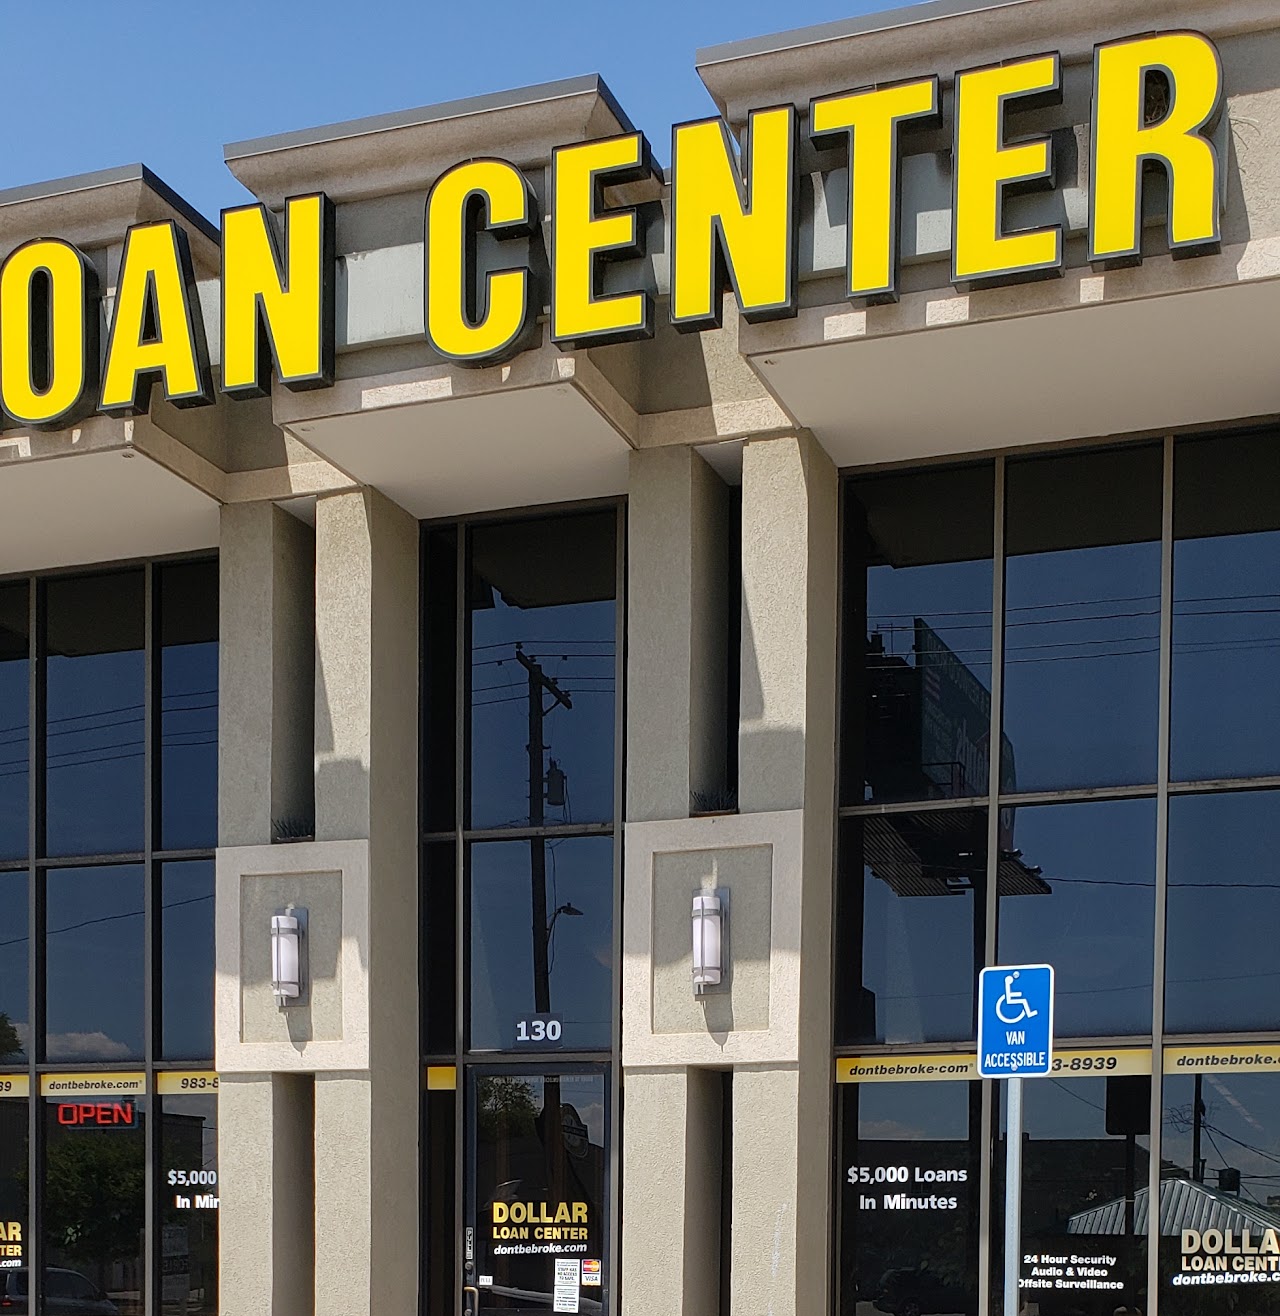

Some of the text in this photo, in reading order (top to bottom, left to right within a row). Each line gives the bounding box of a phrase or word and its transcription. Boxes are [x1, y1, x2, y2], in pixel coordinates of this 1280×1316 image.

[0, 29, 1223, 431] OAN CENTER
[516, 1020, 561, 1041] 130
[1006, 1031, 1025, 1045] VAN
[984, 1052, 1046, 1068] ACCESSIBLE
[1176, 1054, 1280, 1067] dontbebroke.
[57, 1103, 134, 1125] OPEN
[167, 1168, 217, 1186] $5,000
[847, 1165, 968, 1184] $5,000 Loans
[176, 1194, 191, 1209] In
[859, 1193, 958, 1210] In Minutes
[492, 1202, 588, 1224] DOLLAR
[492, 1227, 588, 1240] LOAN CENTER
[1181, 1228, 1280, 1255] DOLLA
[493, 1243, 588, 1255] dontbebroke.com
[1023, 1255, 1117, 1266] 24 Hour Security
[1181, 1255, 1280, 1271] LOAN CENT
[1031, 1267, 1108, 1277] Audio & Video
[1055, 1279, 1124, 1289] Surveillance
